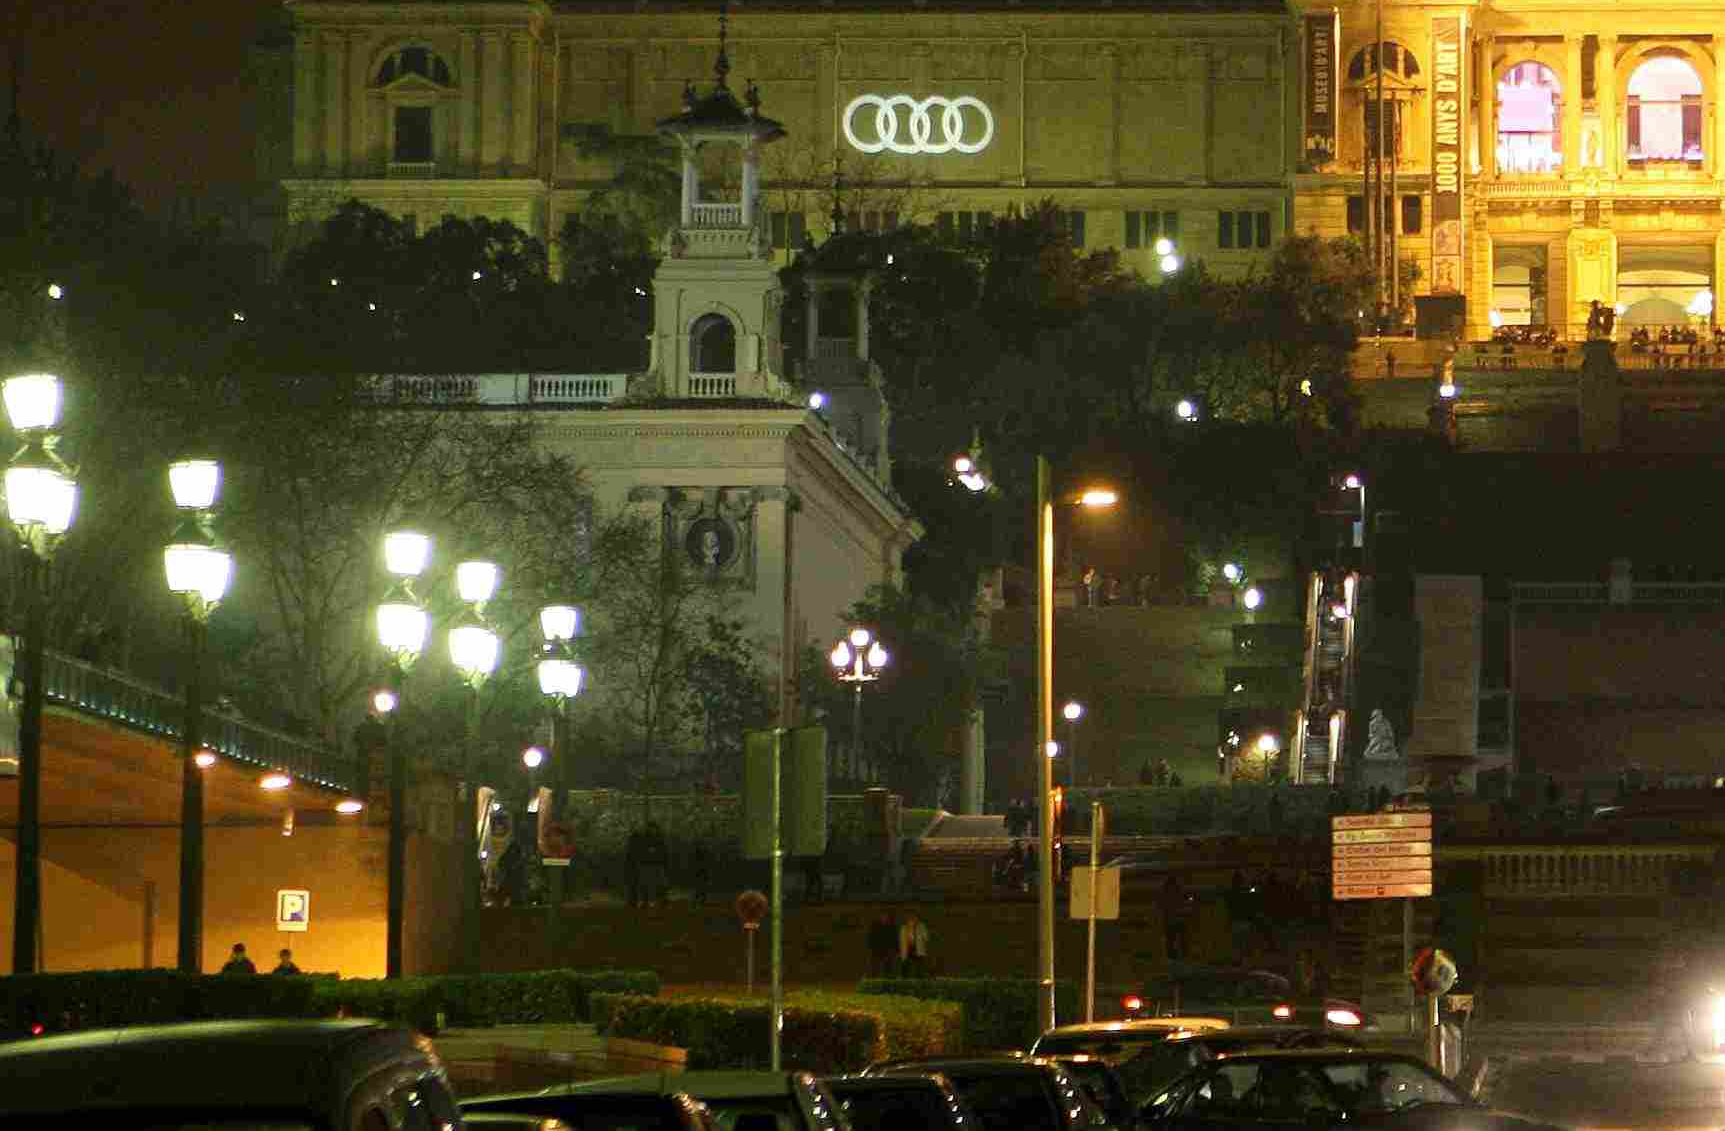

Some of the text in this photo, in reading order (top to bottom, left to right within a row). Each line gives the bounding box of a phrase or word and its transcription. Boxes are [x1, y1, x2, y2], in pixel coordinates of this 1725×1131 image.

[1435, 42, 1458, 193] 1000 ANYS D'ART
